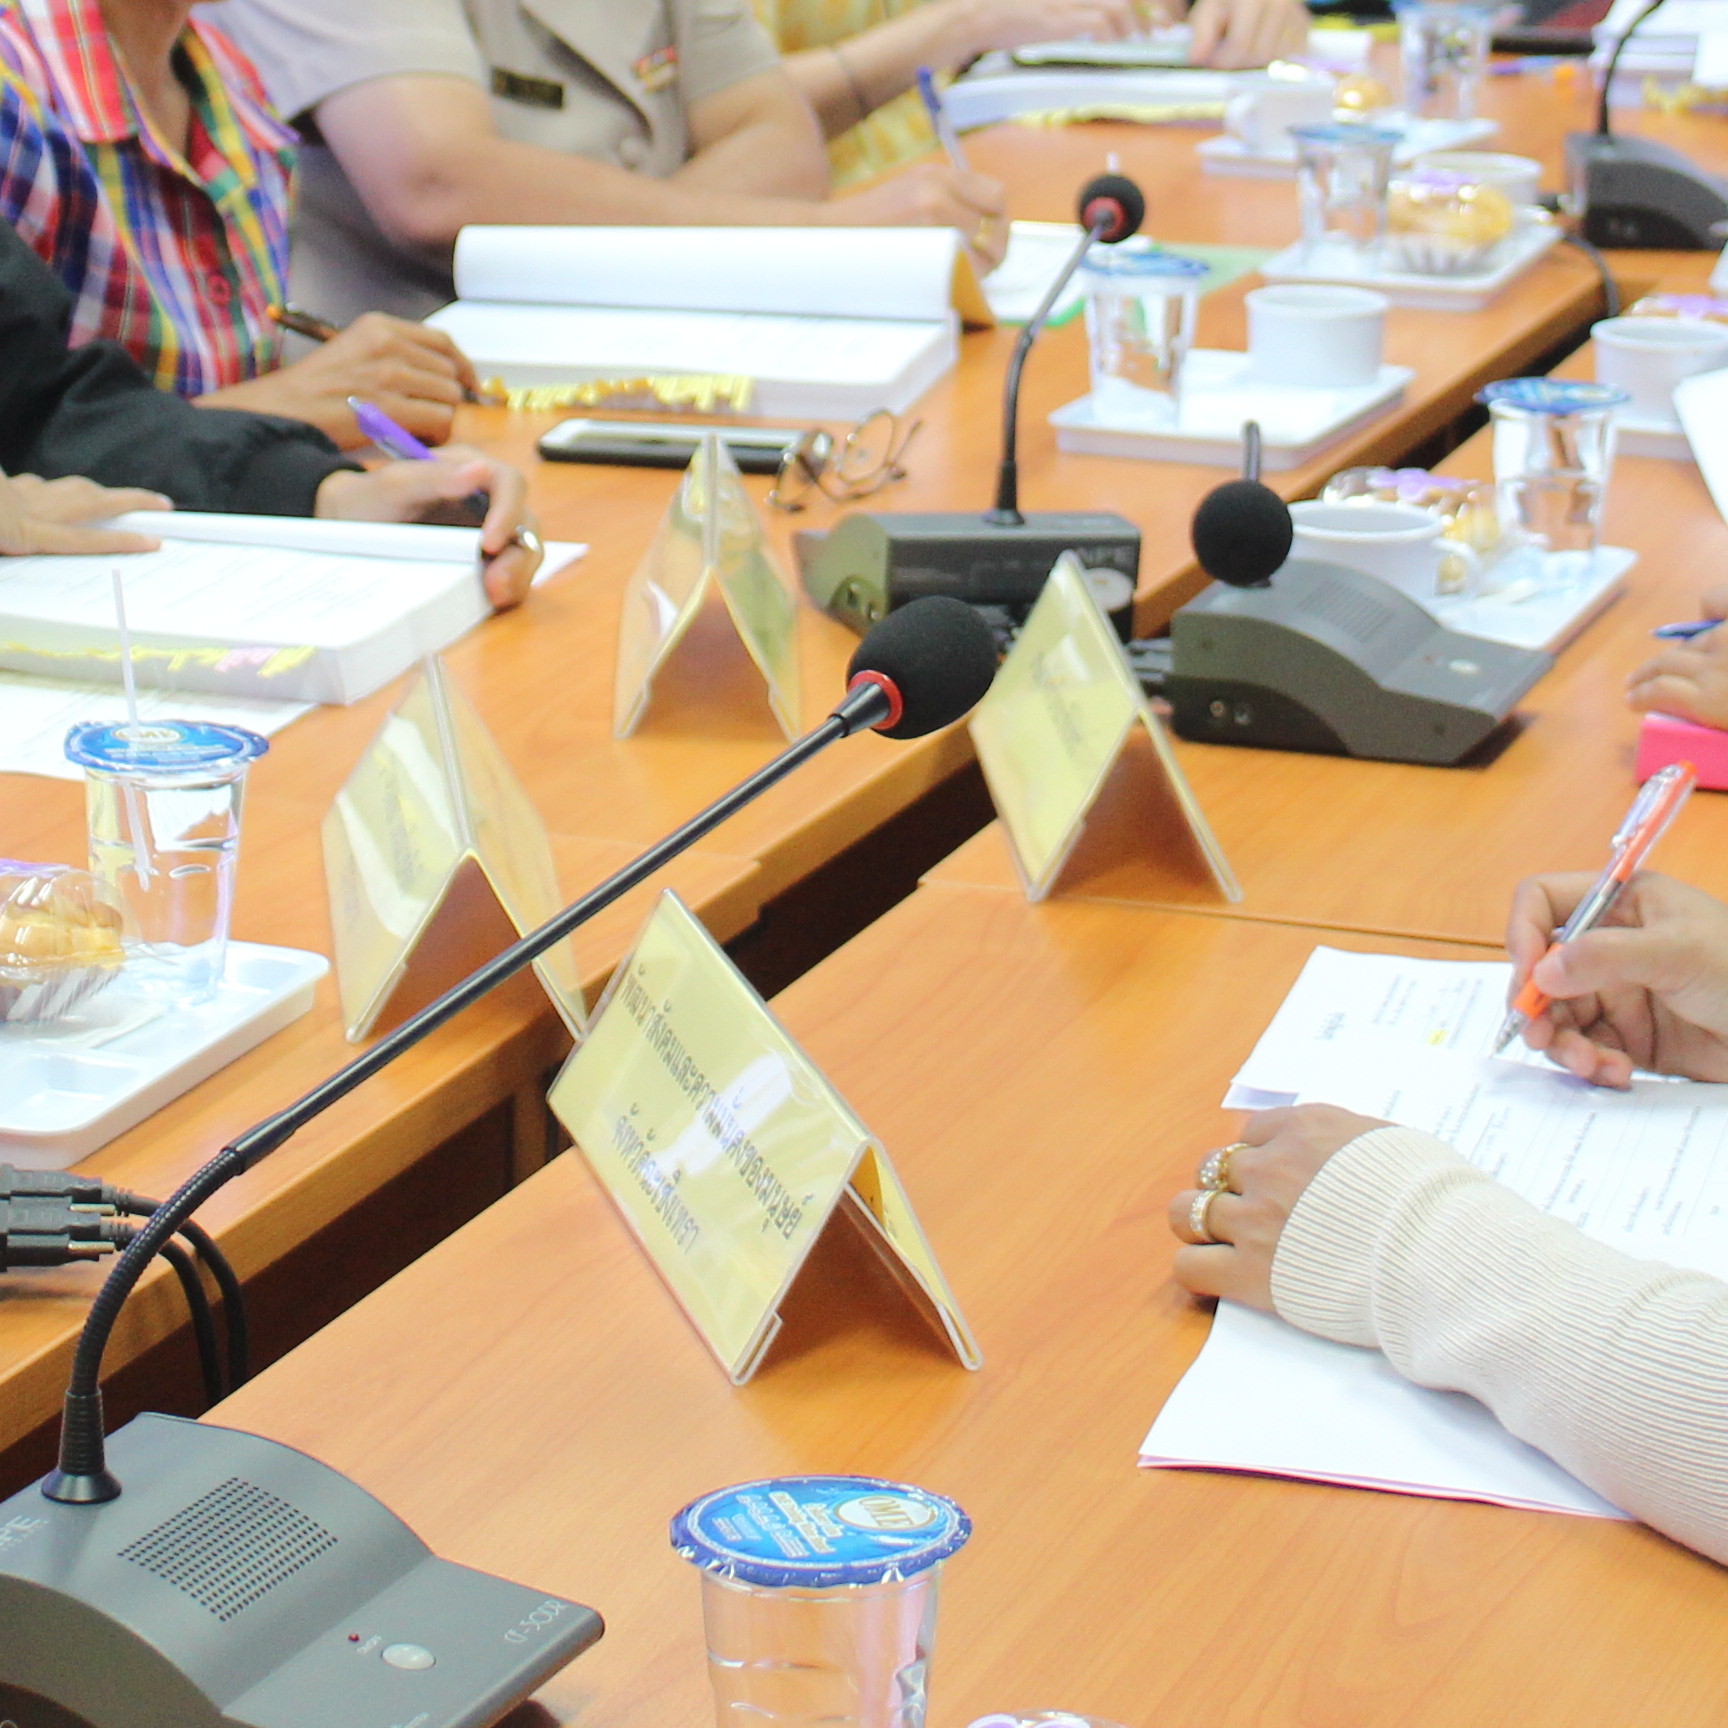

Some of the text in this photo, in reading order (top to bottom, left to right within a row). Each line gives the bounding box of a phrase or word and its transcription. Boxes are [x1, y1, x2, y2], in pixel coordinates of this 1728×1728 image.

[612, 1102, 702, 1254] จังหวัดฉะเชิงเทรา
[620, 964, 815, 1241] พัฒนาสังคมและความมั่นคงของมนุษย์
